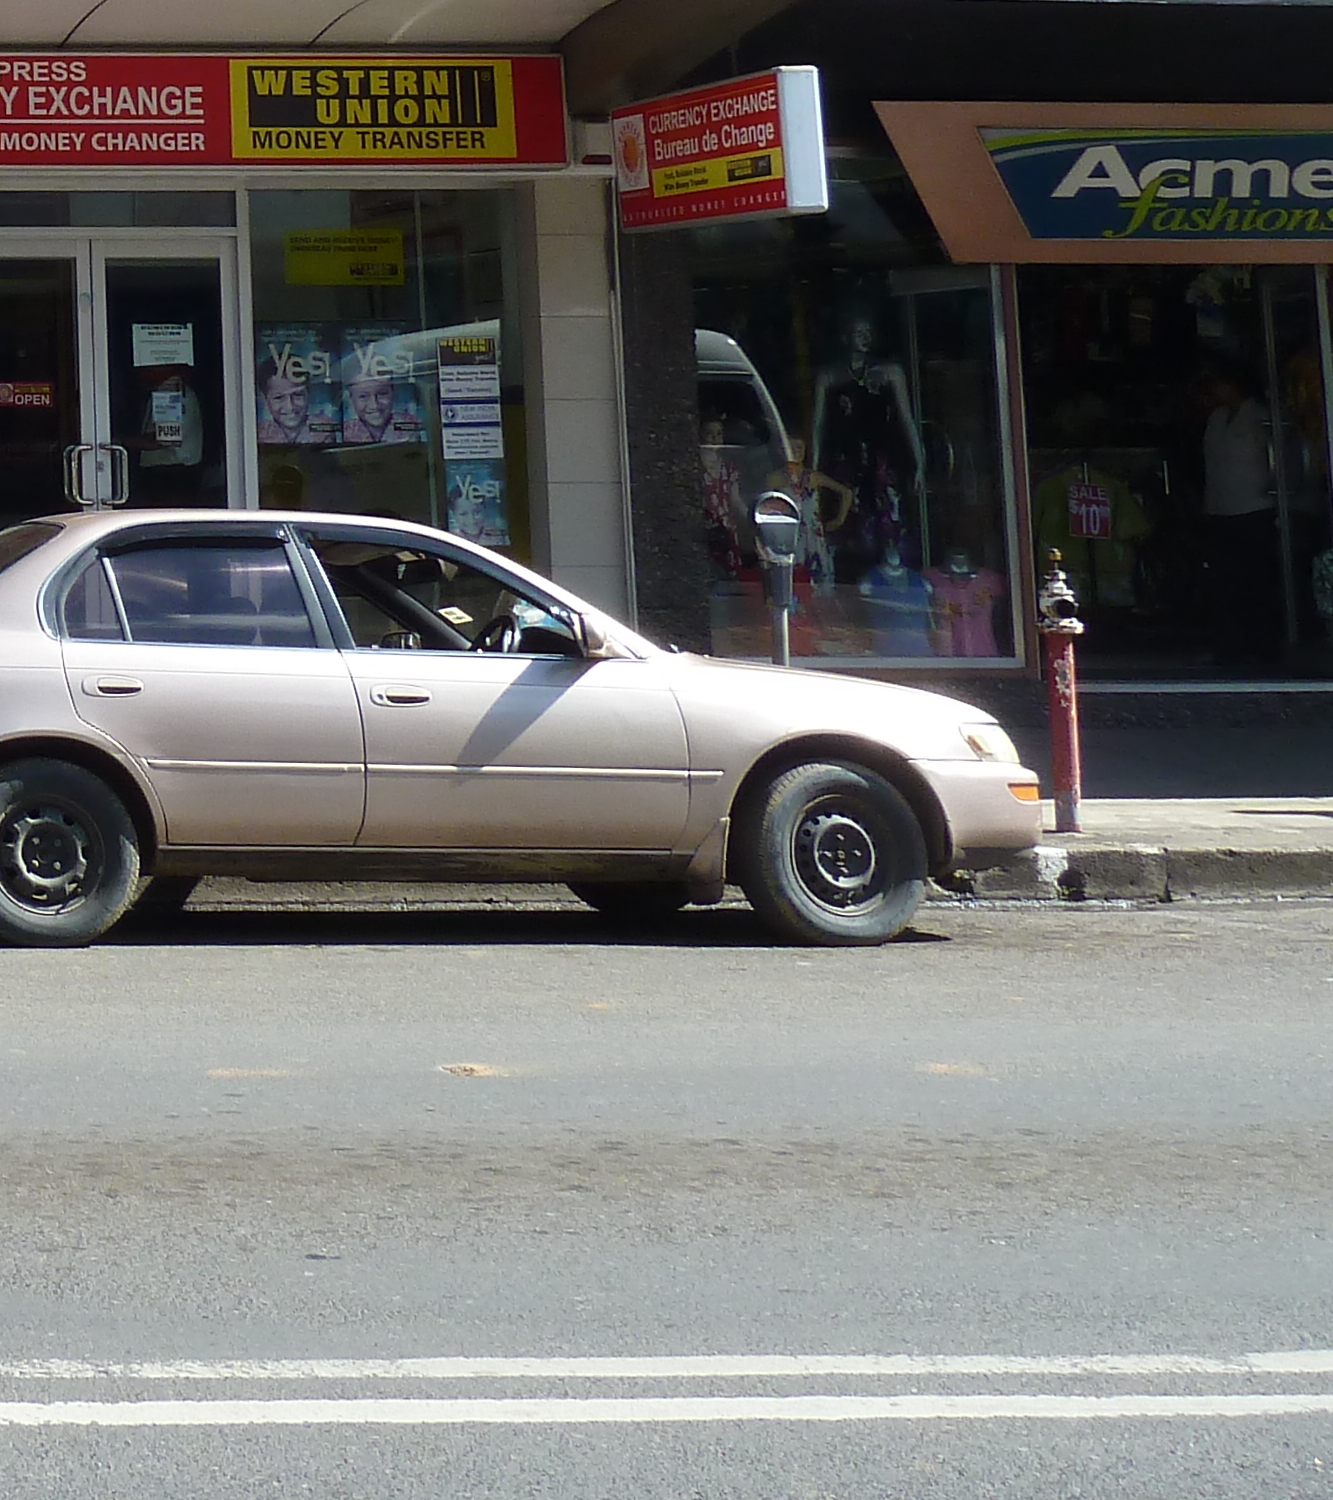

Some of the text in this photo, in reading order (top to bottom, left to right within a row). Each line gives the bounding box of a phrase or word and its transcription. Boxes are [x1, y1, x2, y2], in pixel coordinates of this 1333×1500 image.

[252, 70, 449, 96] WESTERN
[28, 86, 204, 116] EXCHANGE
[316, 99, 450, 124] UNION
[649, 89, 777, 134] CURRENCY EXCHANGE
[0, 132, 85, 151] MONEY
[91, 132, 205, 151] CHANGER
[252, 130, 485, 149] MONEY TRANSFER
[654, 122, 775, 160] Bureau de Change
[1050, 145, 1333, 198] Acme
[269, 343, 331, 384] Yes!
[354, 342, 415, 383] Yes!
[15, 394, 50, 405] OPEN
[158, 425, 181, 437] PUSH
[456, 474, 502, 504] Yes!
[1070, 486, 1106, 500] SALE
